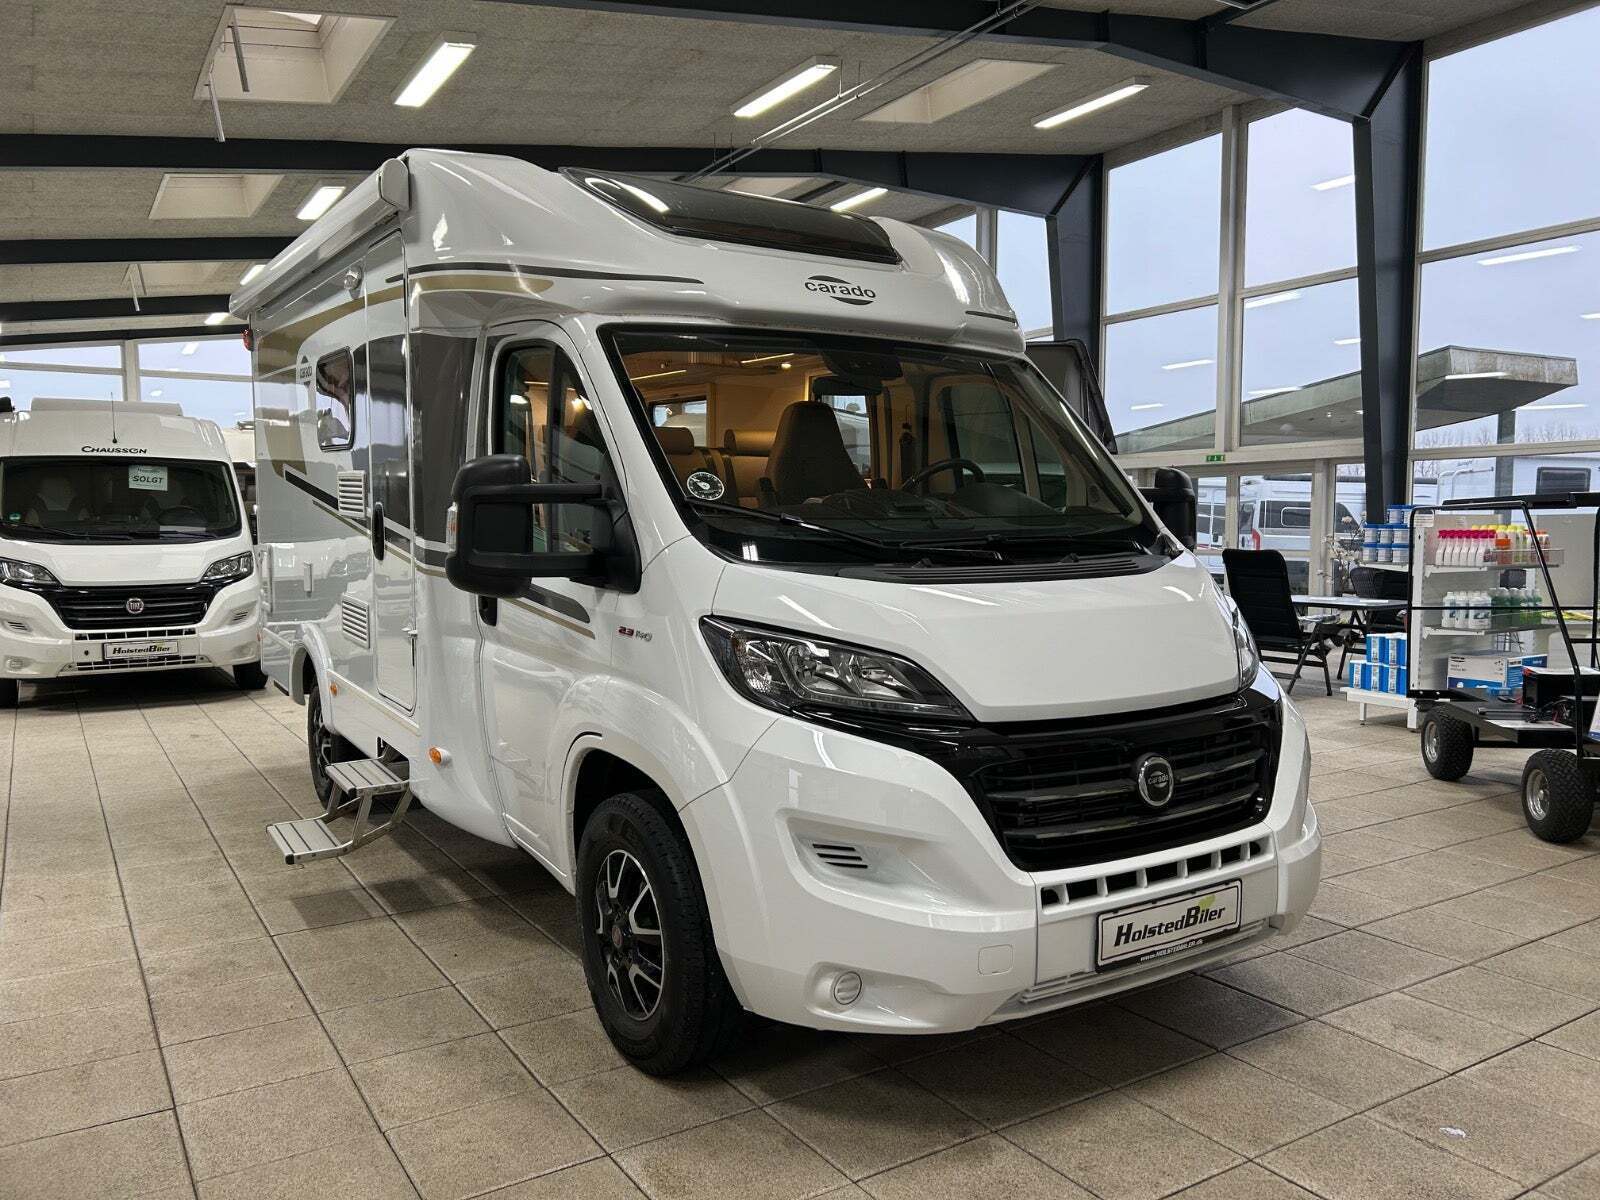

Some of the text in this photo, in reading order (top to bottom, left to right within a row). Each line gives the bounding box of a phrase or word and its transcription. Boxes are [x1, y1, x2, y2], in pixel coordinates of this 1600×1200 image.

[804, 281, 876, 298] carado
[132, 475, 165, 484] SOLGT
[112, 645, 170, 655] HolstedBiler
[1114, 905, 1226, 948] HolstedBiler
